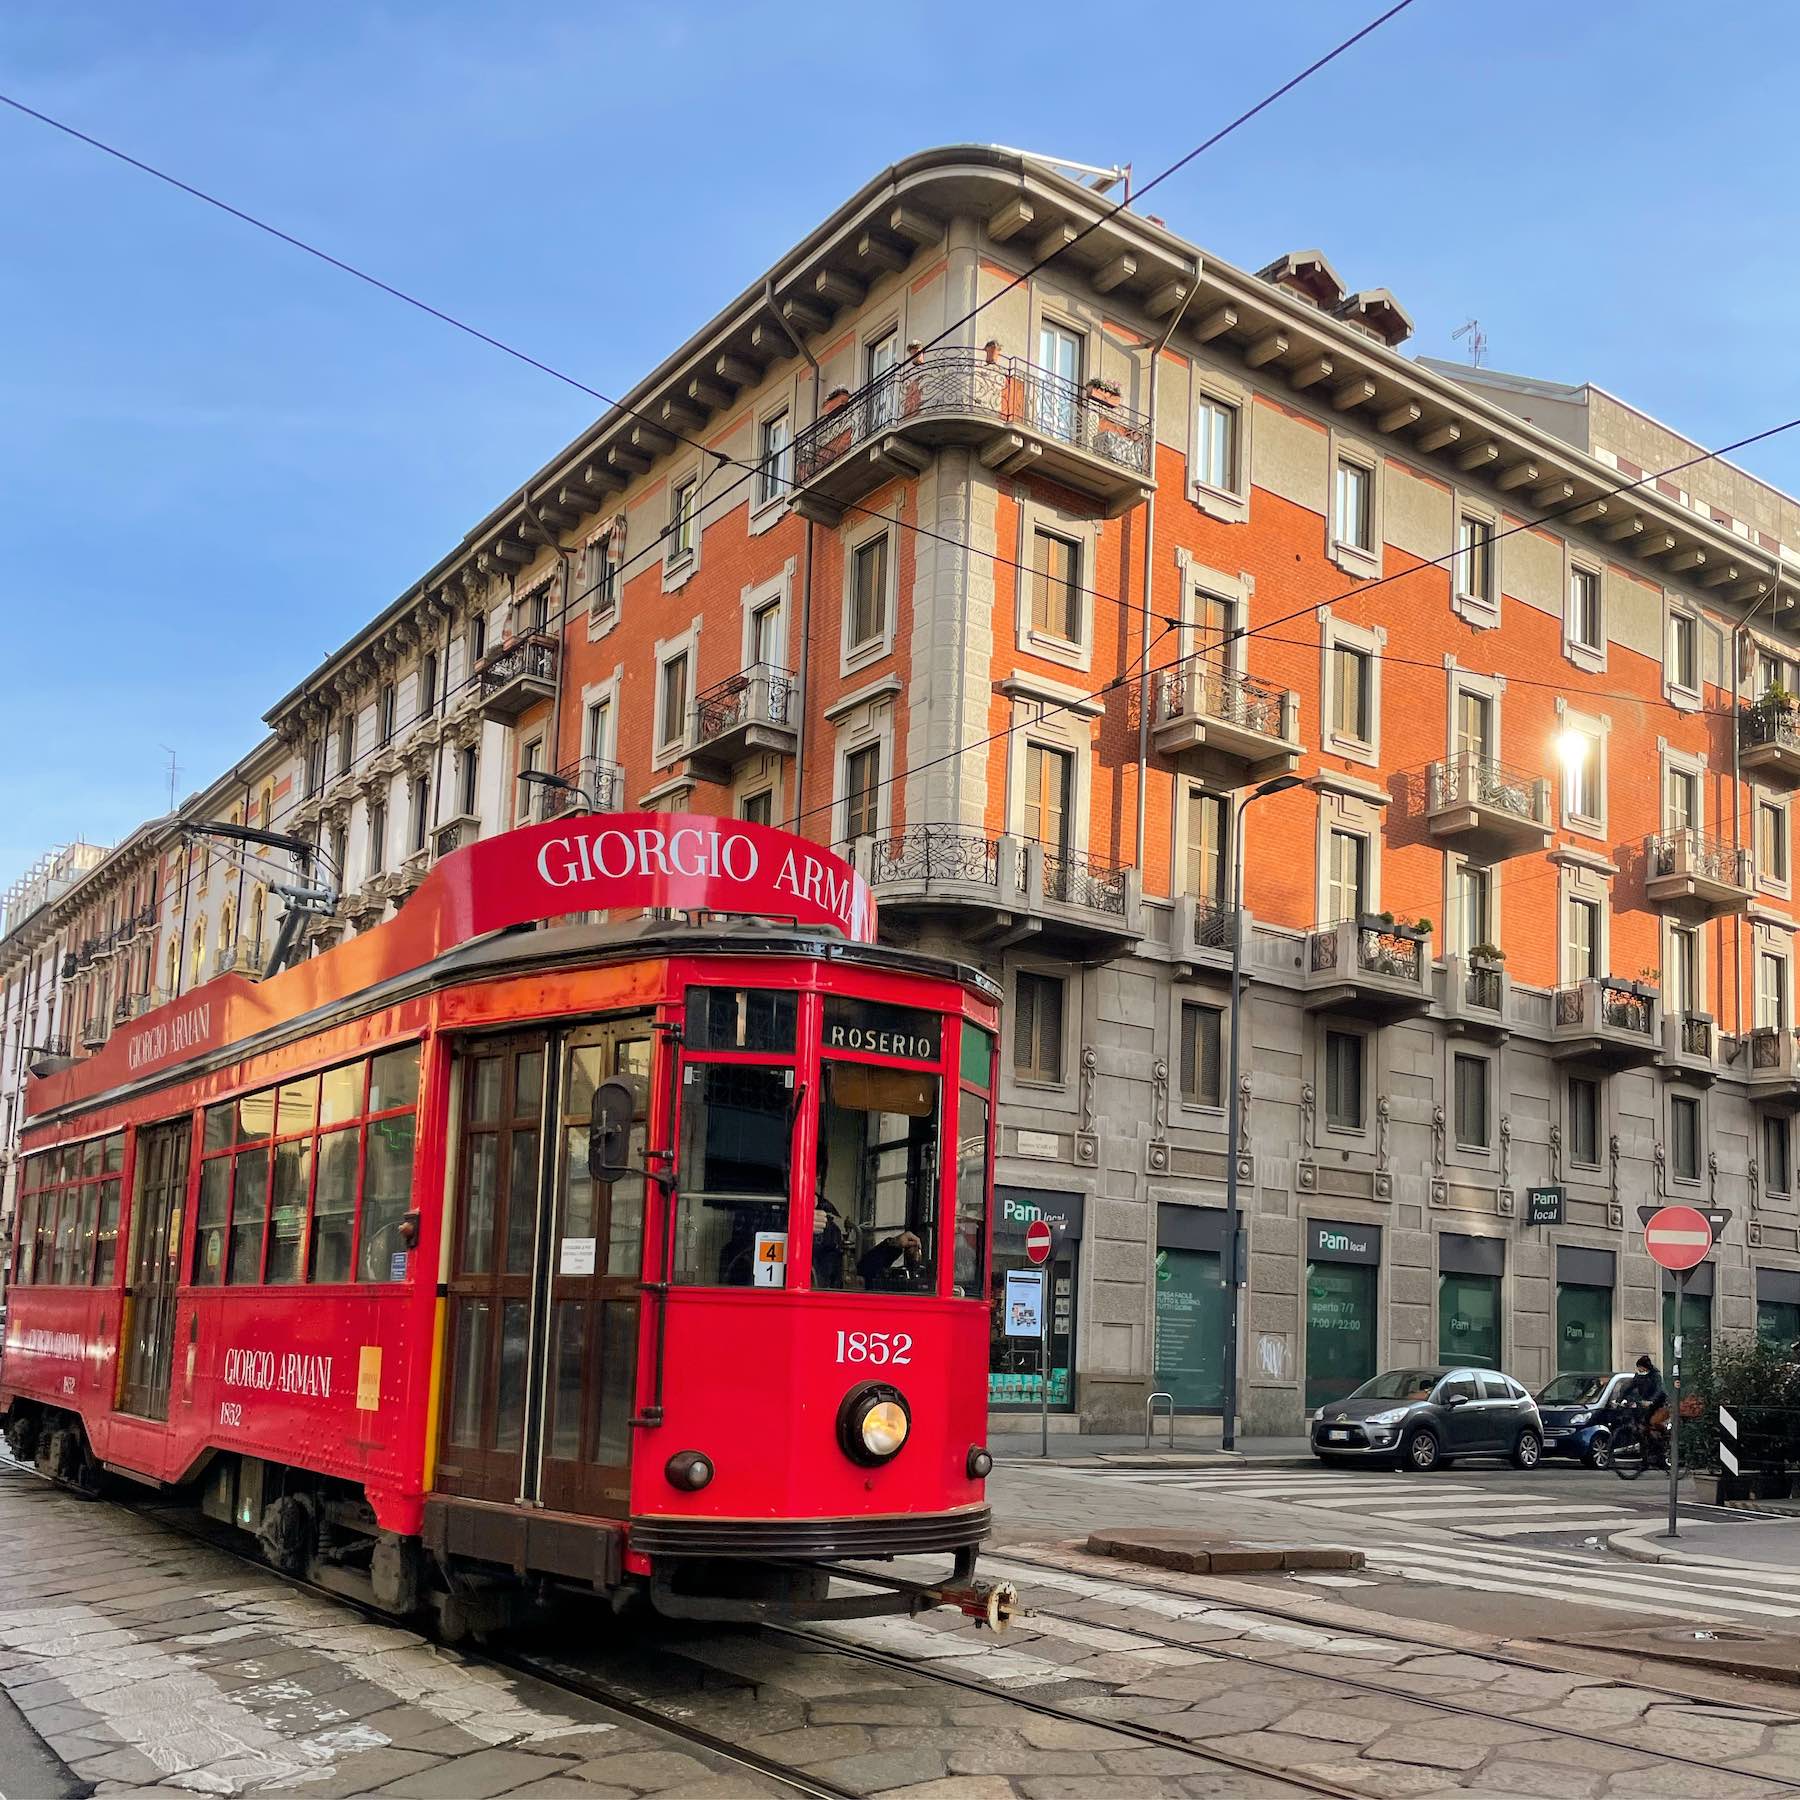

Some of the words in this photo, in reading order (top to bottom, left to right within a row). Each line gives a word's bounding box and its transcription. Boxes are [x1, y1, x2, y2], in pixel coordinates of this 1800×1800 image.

[537, 828, 759, 887] GIORGIO
[128, 1023, 167, 1070] GIORGIO
[169, 1002, 210, 1053] ARMANI
[831, 1024, 931, 1059] ROSERIO
[1532, 1192, 1558, 1205] Pam
[1003, 1199, 1041, 1221] Pam
[1533, 1208, 1557, 1220] local
[1319, 1230, 1349, 1250] Pam
[1350, 1241, 1367, 1253] local
[766, 1243, 776, 1261] 4
[766, 1264, 773, 1281] 1
[1312, 1303, 1338, 1314] aperto
[1341, 1302, 1355, 1313] 7/7
[1312, 1317, 1329, 1328] 7:00
[1338, 1320, 1360, 1330] 22:00
[1451, 1318, 1469, 1330] Pam
[1566, 1325, 1583, 1338] Pam
[836, 1331, 913, 1365] 1852
[224, 1347, 274, 1390] GIORGIO
[277, 1353, 333, 1398] ARMANI
[220, 1401, 241, 1427] 1852
